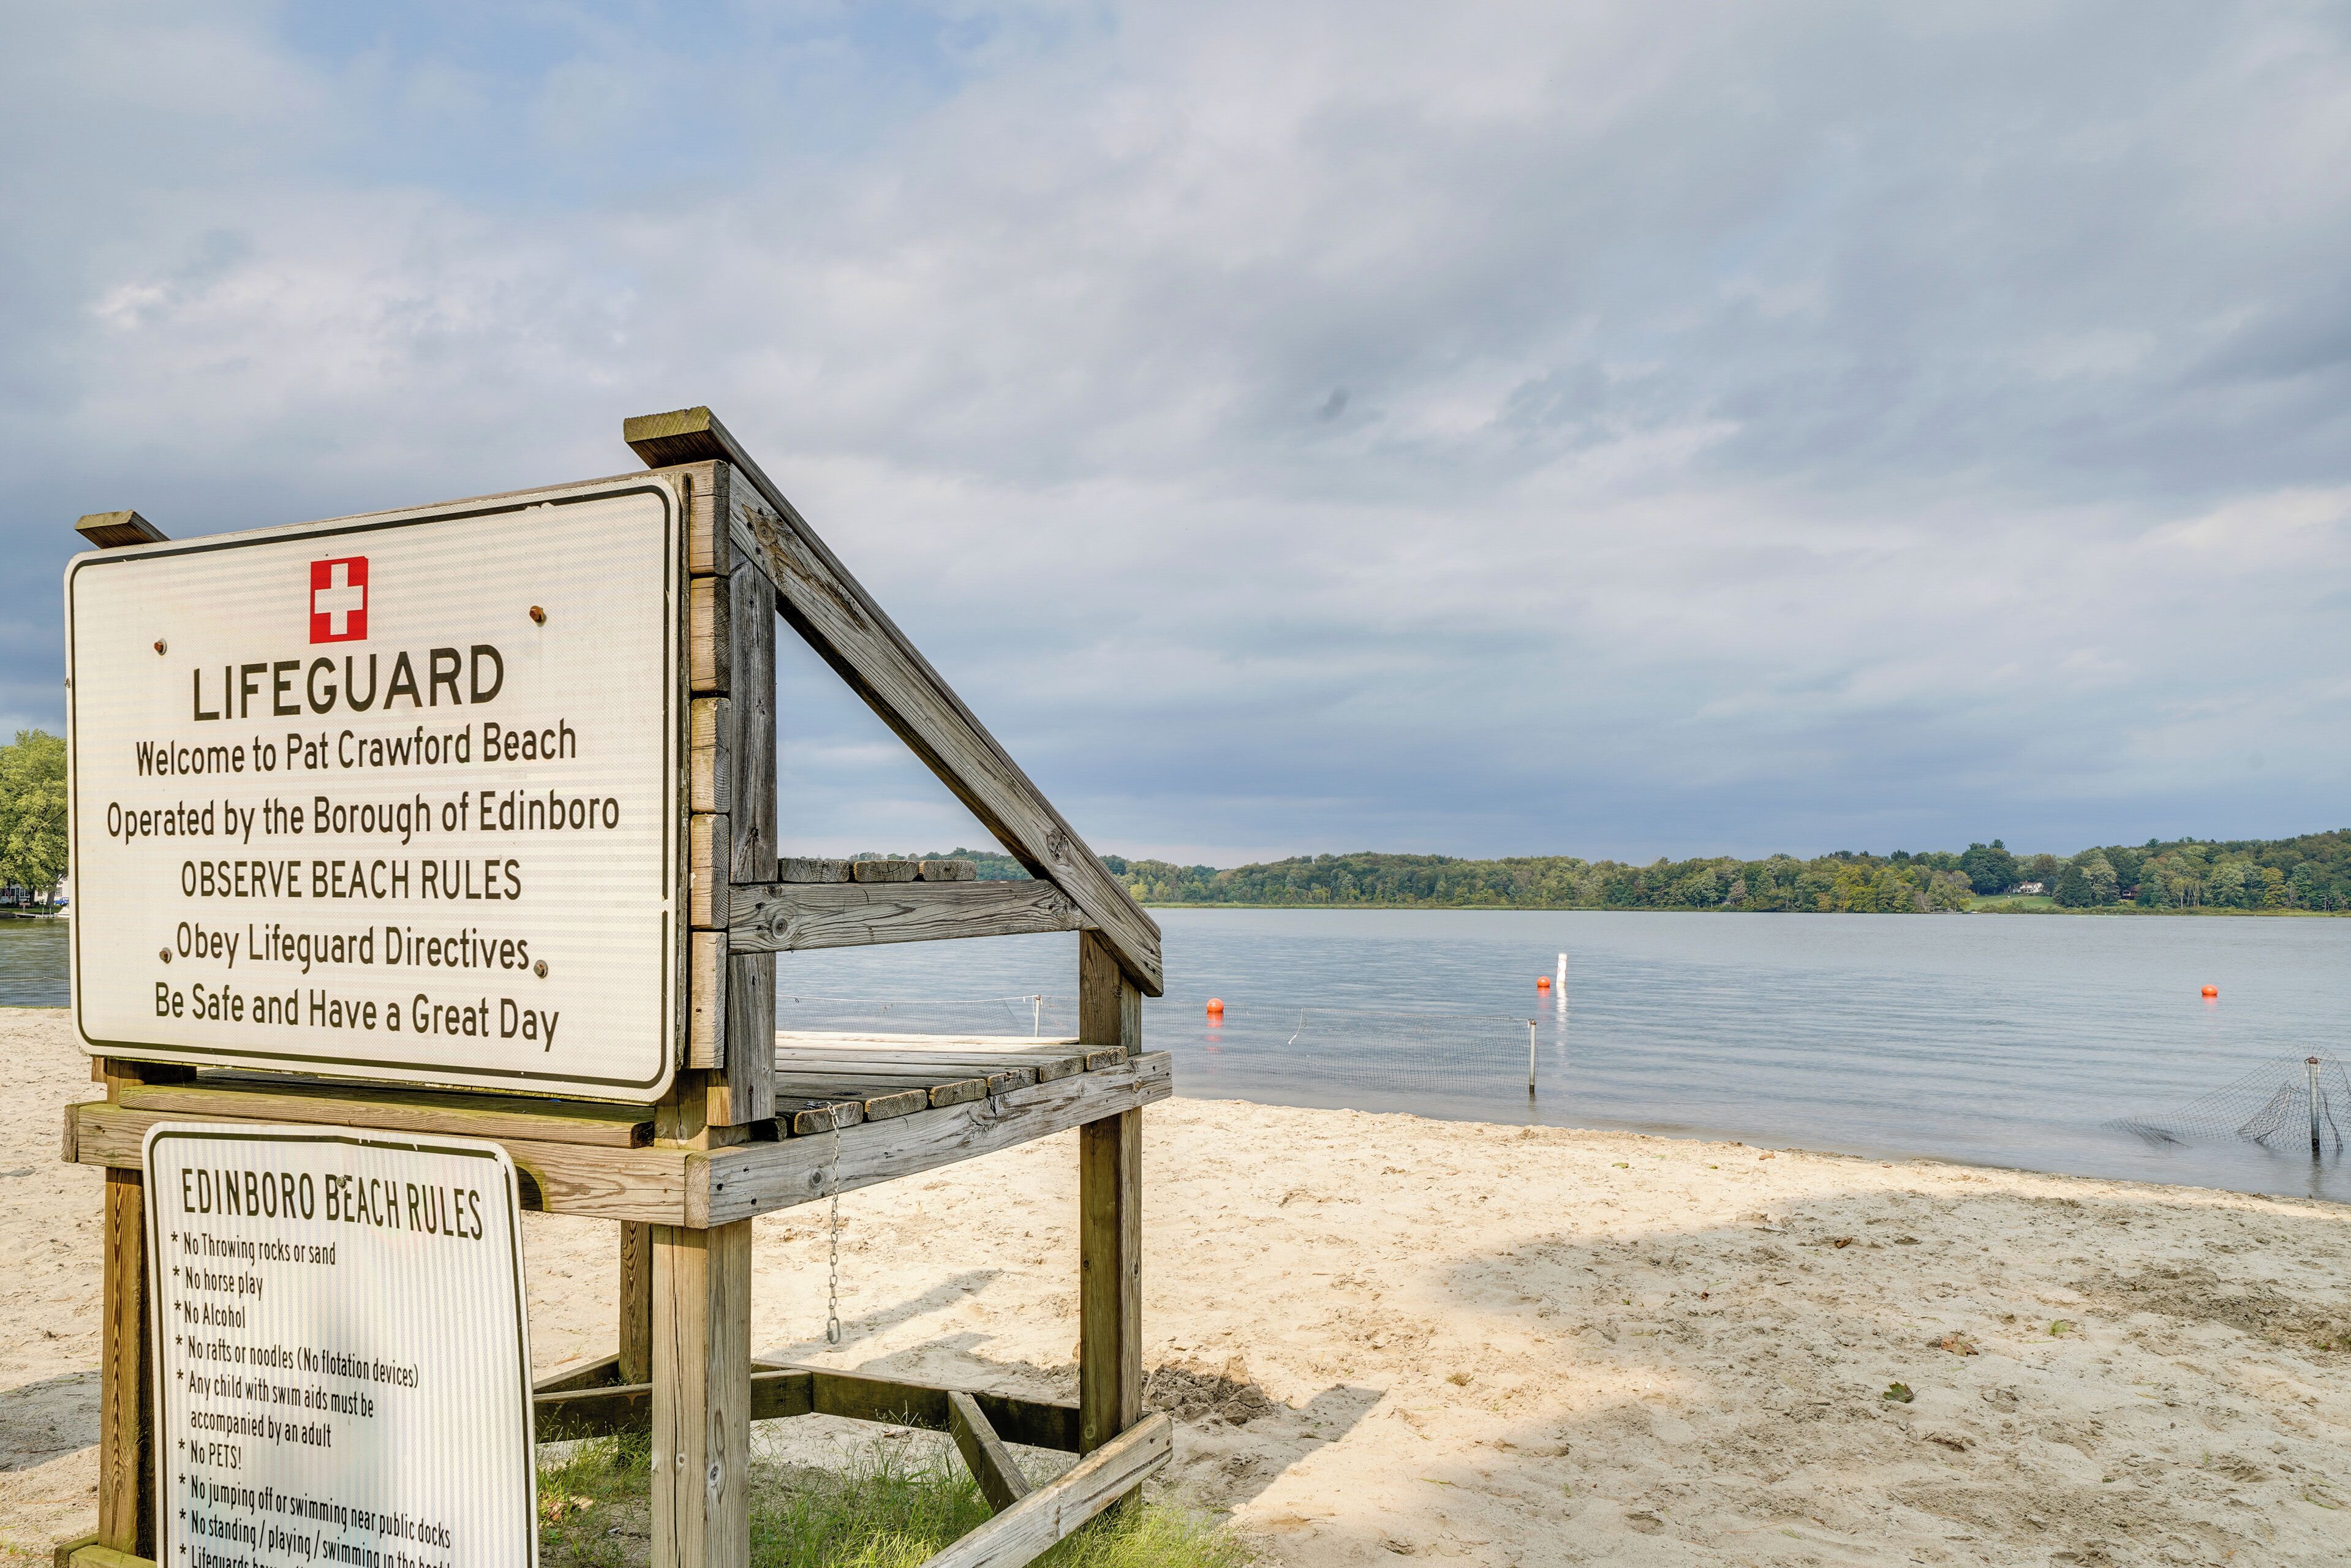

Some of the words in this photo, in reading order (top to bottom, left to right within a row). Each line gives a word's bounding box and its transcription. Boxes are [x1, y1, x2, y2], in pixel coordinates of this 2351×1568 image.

[194, 644, 504, 722] LIFEGUARD
[136, 739, 245, 777] Welcome
[252, 735, 276, 772] to
[287, 731, 329, 771] Pat
[338, 723, 470, 769] Crawford
[483, 717, 576, 762] Beach
[107, 799, 214, 845] Operated
[224, 799, 255, 845] by
[263, 797, 304, 835] the
[314, 793, 431, 846] Borough
[442, 791, 469, 832] of
[480, 788, 619, 831] Edinboro
[181, 861, 302, 898] OBSERVE
[312, 859, 409, 899] BEACH
[421, 859, 521, 900] RULES
[177, 921, 240, 969] Obey
[249, 923, 374, 975] Lifeguard
[386, 926, 529, 970] Directives
[156, 982, 184, 1018] Be
[192, 983, 244, 1022] Safe
[252, 988, 298, 1025] and
[310, 989, 377, 1030] Have
[386, 1002, 400, 1031] a
[412, 993, 489, 1038] Great
[500, 998, 559, 1052] Day
[181, 1168, 314, 1220] EDINBORO
[325, 1174, 400, 1229] BEACH
[406, 1183, 483, 1241] RULES
[183, 1232, 198, 1255] No
[201, 1232, 255, 1267] Throwing
[258, 1237, 290, 1262] rocks
[293, 1245, 306, 1262] or
[309, 1242, 336, 1265] sand
[185, 1266, 200, 1290] No
[204, 1268, 235, 1292] horse
[238, 1271, 263, 1301] play
[184, 1300, 199, 1324] No
[203, 1302, 245, 1329] Alcohol
[188, 1335, 203, 1359] No
[206, 1338, 232, 1362] rafts
[235, 1346, 246, 1364] or
[250, 1344, 293, 1370] noodles
[297, 1346, 319, 1373] (No
[322, 1349, 369, 1381] flotation
[372, 1357, 418, 1389] devices)
[189, 1370, 211, 1401] Any
[214, 1373, 241, 1399] child
[245, 1377, 269, 1403] with
[272, 1385, 301, 1407] swim
[304, 1384, 328, 1411] aids
[331, 1390, 358, 1415] must
[361, 1392, 374, 1419] be
[191, 1411, 264, 1438] accompanied
[268, 1414, 282, 1446] by
[284, 1423, 298, 1442] an
[301, 1421, 331, 1448] adult
[191, 1439, 205, 1464] No
[209, 1442, 241, 1470] PETS!
[191, 1474, 205, 1500] No
[208, 1477, 255, 1516] jumping
[258, 1486, 273, 1512] off
[276, 1494, 287, 1513] or
[290, 1492, 347, 1534] swimming
[351, 1508, 376, 1531] near
[379, 1511, 415, 1540] public
[418, 1517, 450, 1549] docks
[191, 1509, 206, 1536] No
[208, 1513, 256, 1553] standing
[258, 1519, 266, 1549] /
[268, 1525, 311, 1563] playing
[313, 1529, 320, 1559] /
[322, 1536, 380, 1568] swimming
